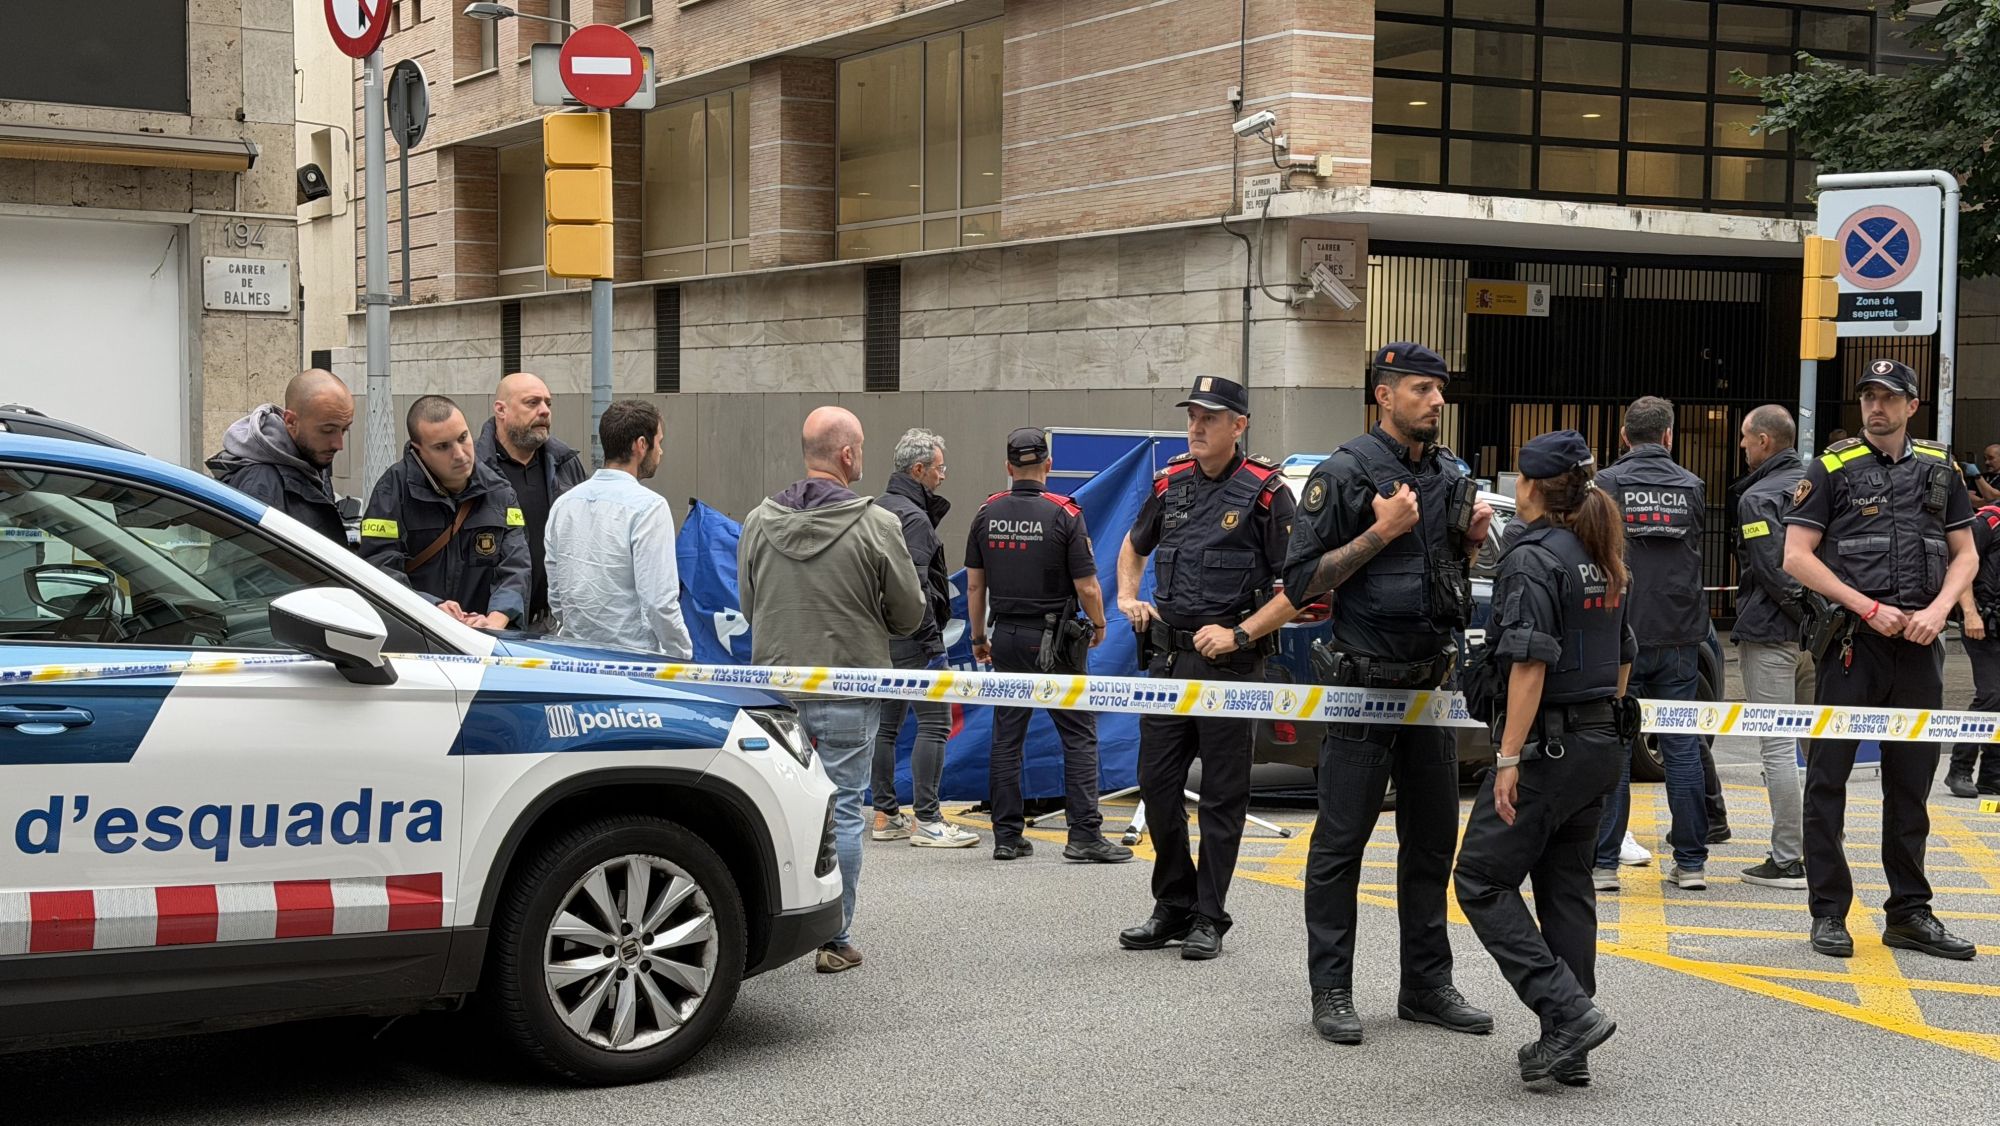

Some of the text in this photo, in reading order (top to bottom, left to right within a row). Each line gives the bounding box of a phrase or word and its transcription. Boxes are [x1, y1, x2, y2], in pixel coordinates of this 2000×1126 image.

[224, 222, 266, 250] 194
[1317, 243, 1341, 252] CARRER
[228, 264, 266, 275] CARRER
[242, 278, 253, 288] DE
[224, 291, 271, 306] BALMES
[1856, 296, 1895, 306] Zona de
[1852, 308, 1898, 319] seguretat
[1624, 492, 1688, 507] POLICIA
[1852, 496, 1888, 506] POLICIA
[363, 524, 386, 533] LICIA
[988, 520, 1043, 534] POLICIA
[832, 682, 876, 692] POLICIA
[978, 688, 1033, 699] NO PASSEU
[1089, 695, 1129, 707] POLICIA
[1223, 700, 1273, 711] NO PASSEU
[1324, 706, 1361, 717] POLICIA
[1448, 710, 1468, 719] SSEU
[578, 707, 662, 734] policia
[1655, 717, 1698, 727] NO PASSEU
[1742, 722, 1773, 732] POLICIA
[1848, 724, 1887, 733] NO PASSEU
[1928, 728, 1958, 738] POLICIA
[14, 787, 443, 862] d'esquadra
